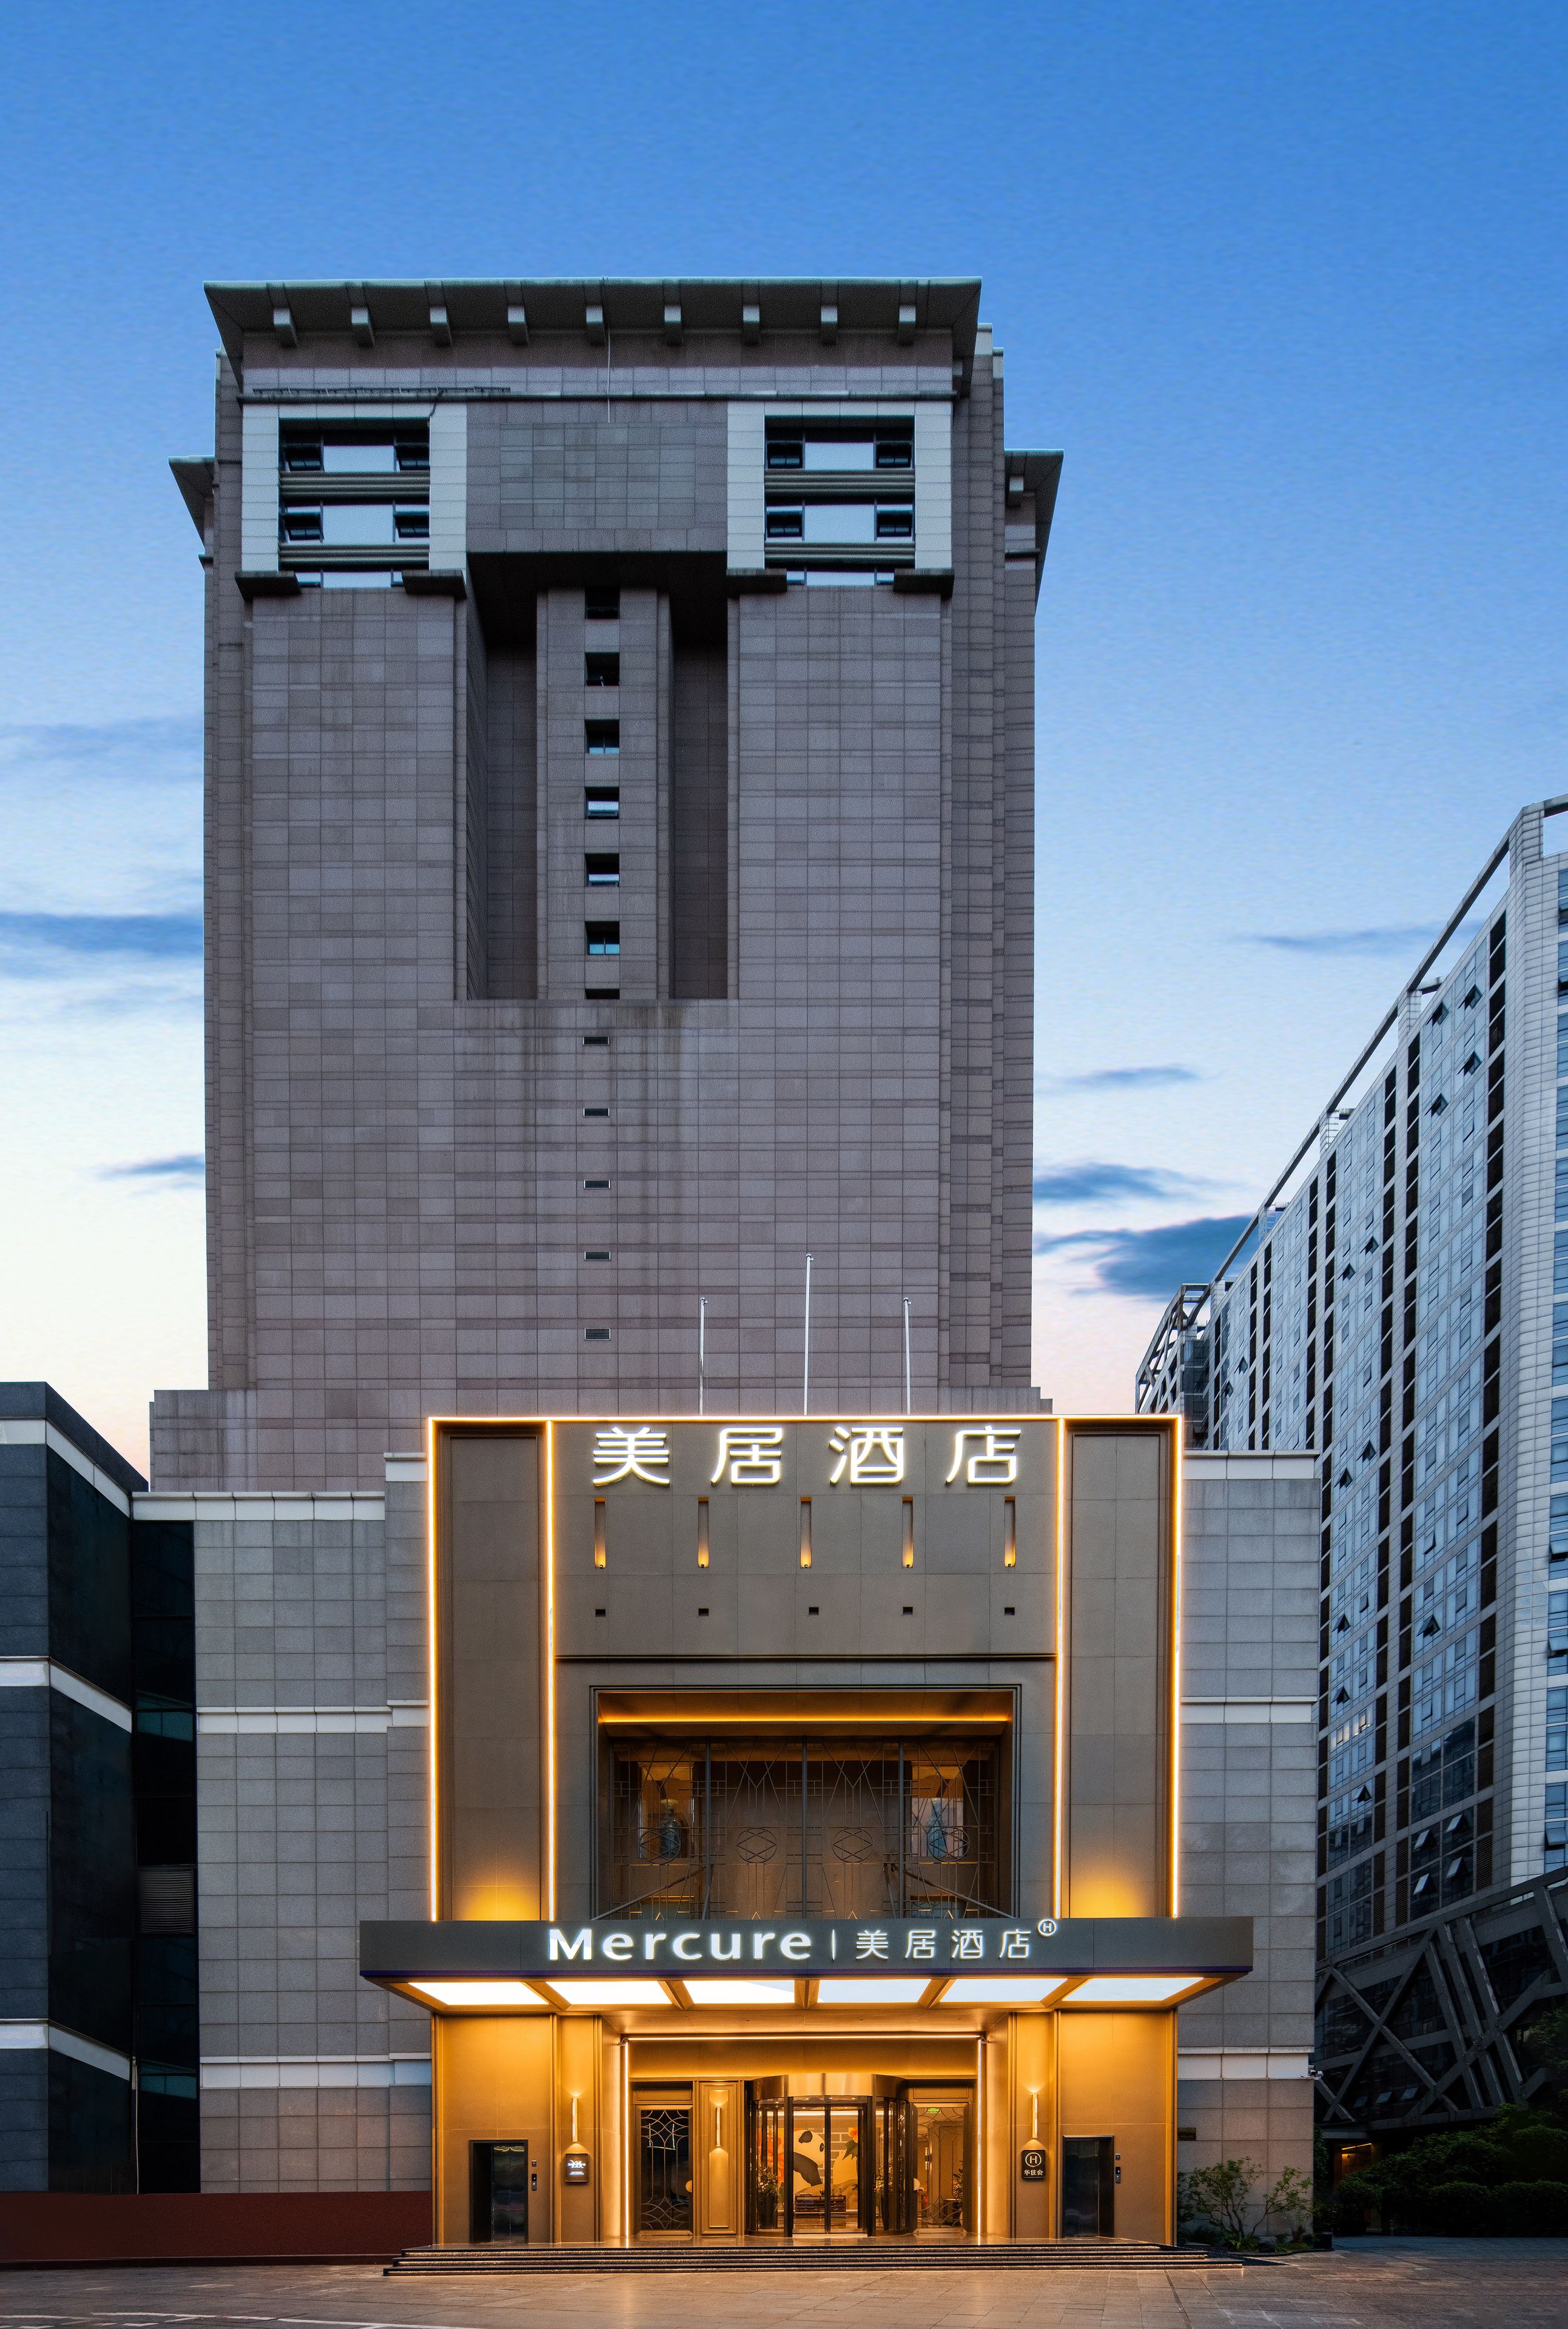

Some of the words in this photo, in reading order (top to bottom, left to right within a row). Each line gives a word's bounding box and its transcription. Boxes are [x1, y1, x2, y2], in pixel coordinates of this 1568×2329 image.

[593, 1425, 1021, 1485] 美居酒店
[549, 1928, 812, 1960] Mercure
[856, 1929, 1031, 1960] 美居酒店
